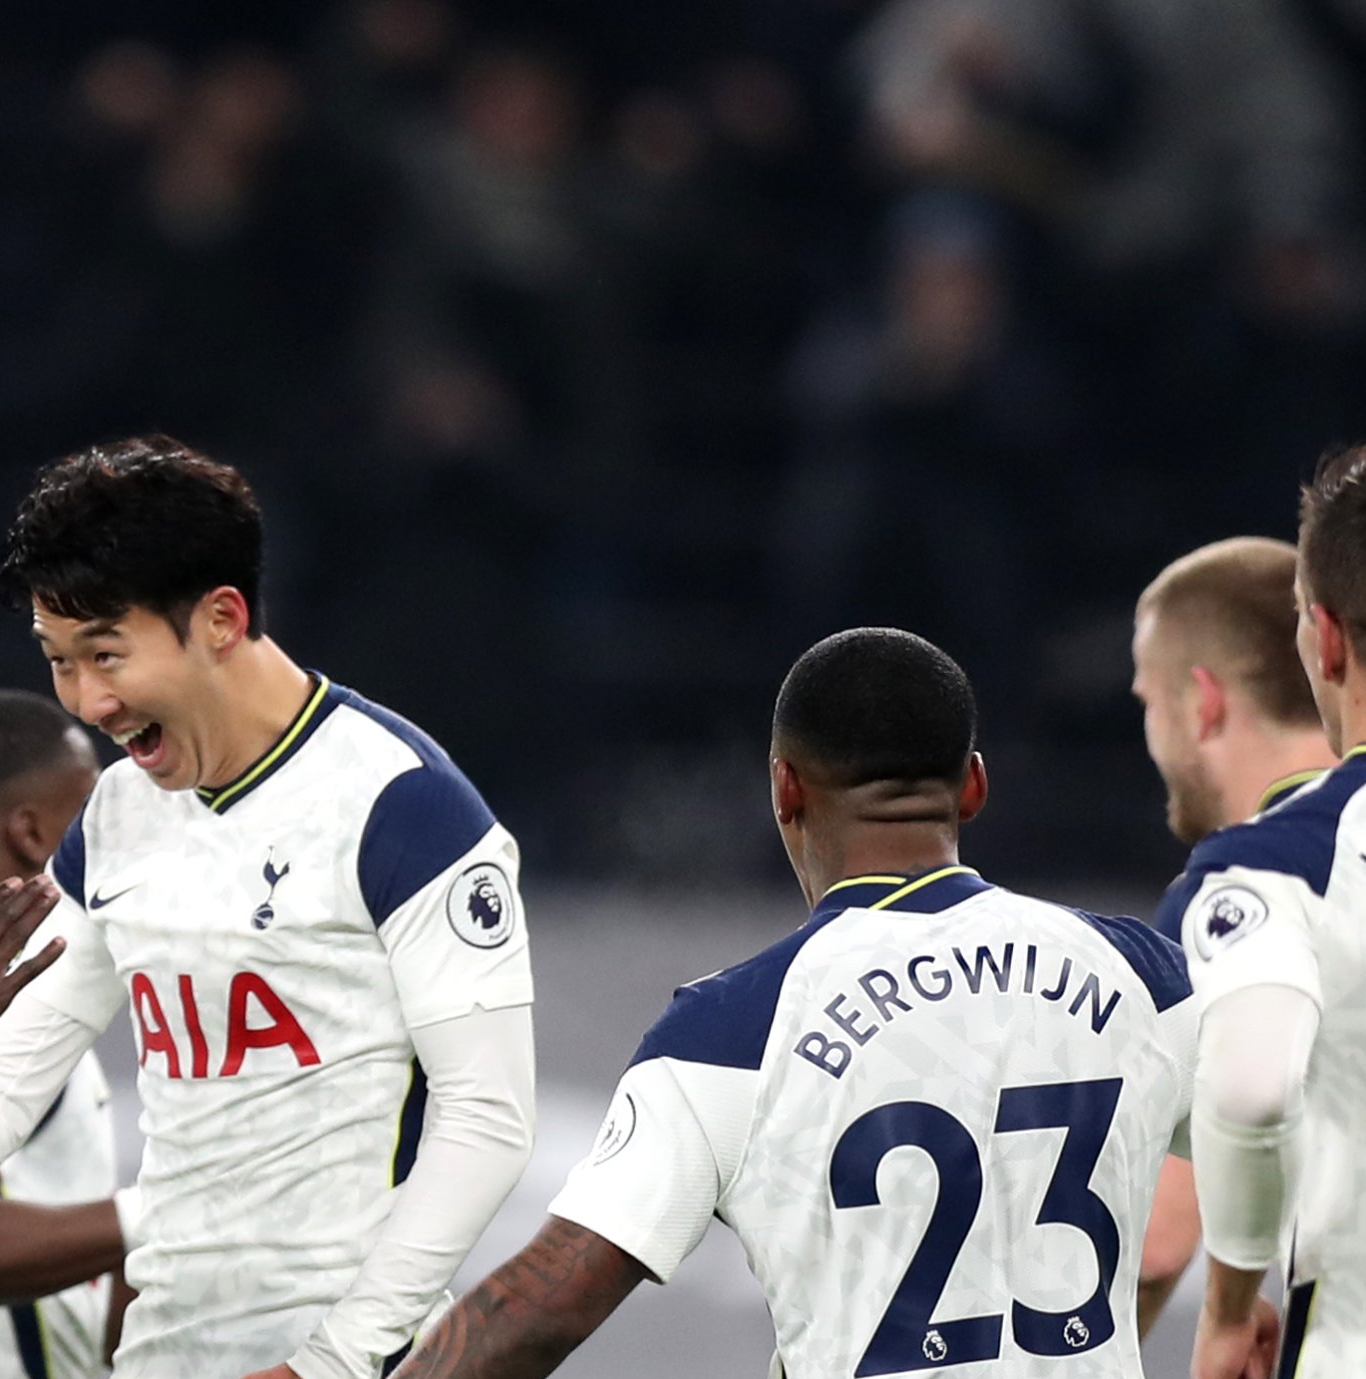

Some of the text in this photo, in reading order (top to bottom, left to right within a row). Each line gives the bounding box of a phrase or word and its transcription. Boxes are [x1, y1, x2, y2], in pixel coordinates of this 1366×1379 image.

[131, 972, 321, 1078] AIA
[793, 942, 1121, 1079] BERGWIJN
[829, 1077, 1123, 1379] 23
